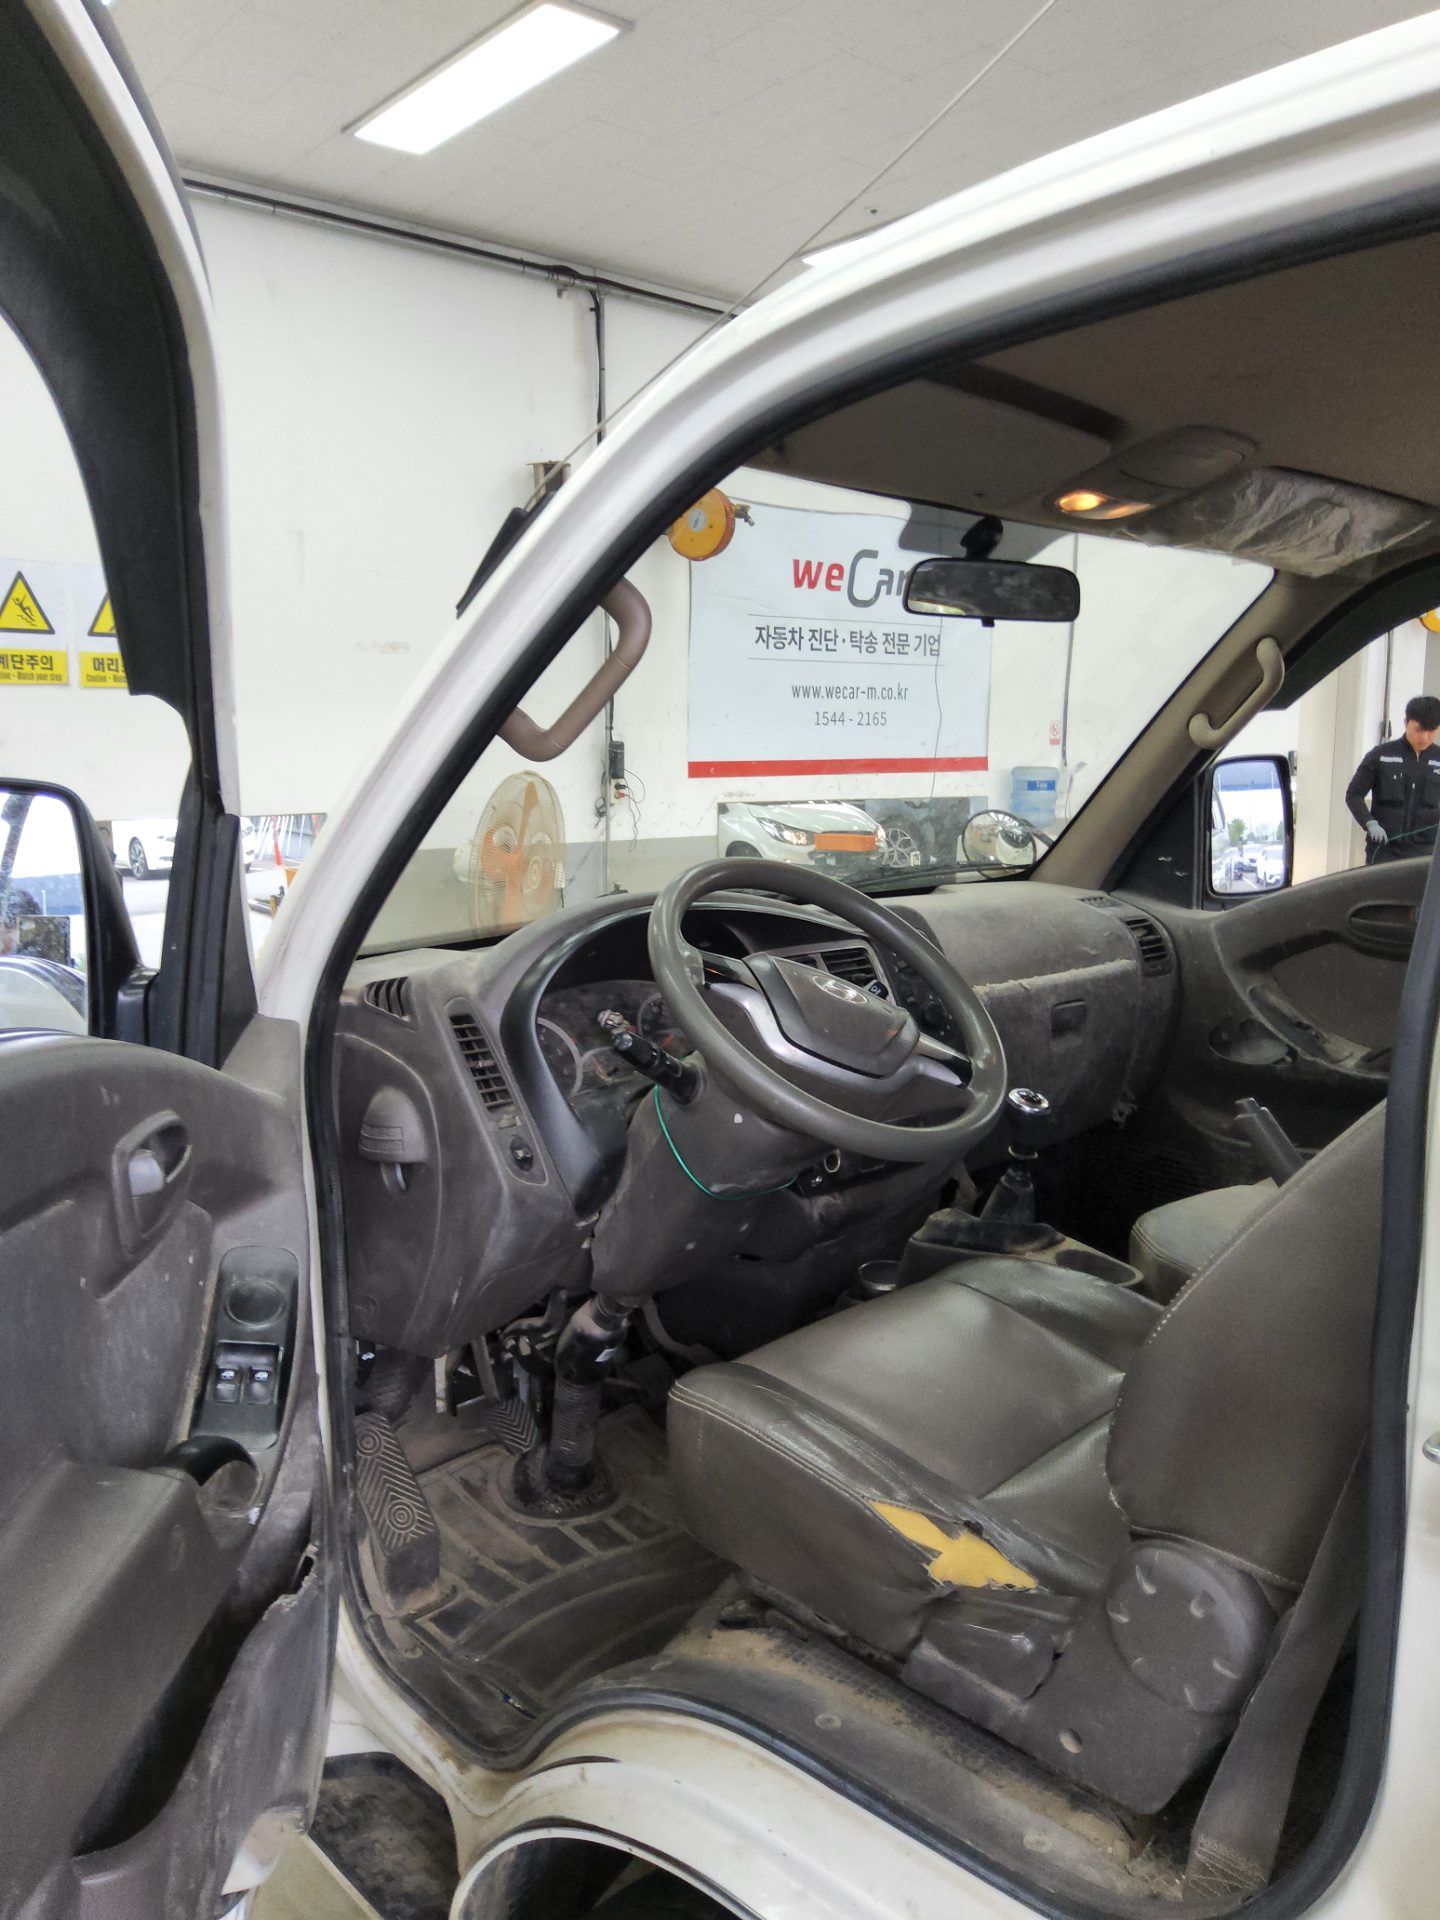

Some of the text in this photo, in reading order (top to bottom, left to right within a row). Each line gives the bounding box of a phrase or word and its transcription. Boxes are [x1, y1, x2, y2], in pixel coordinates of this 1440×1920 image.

[754, 624, 804, 651] 자동차
[882, 631, 911, 656] 전문
[913, 633, 941, 657] 기업
[791, 683, 909, 701] www.wecar-m.co.kr
